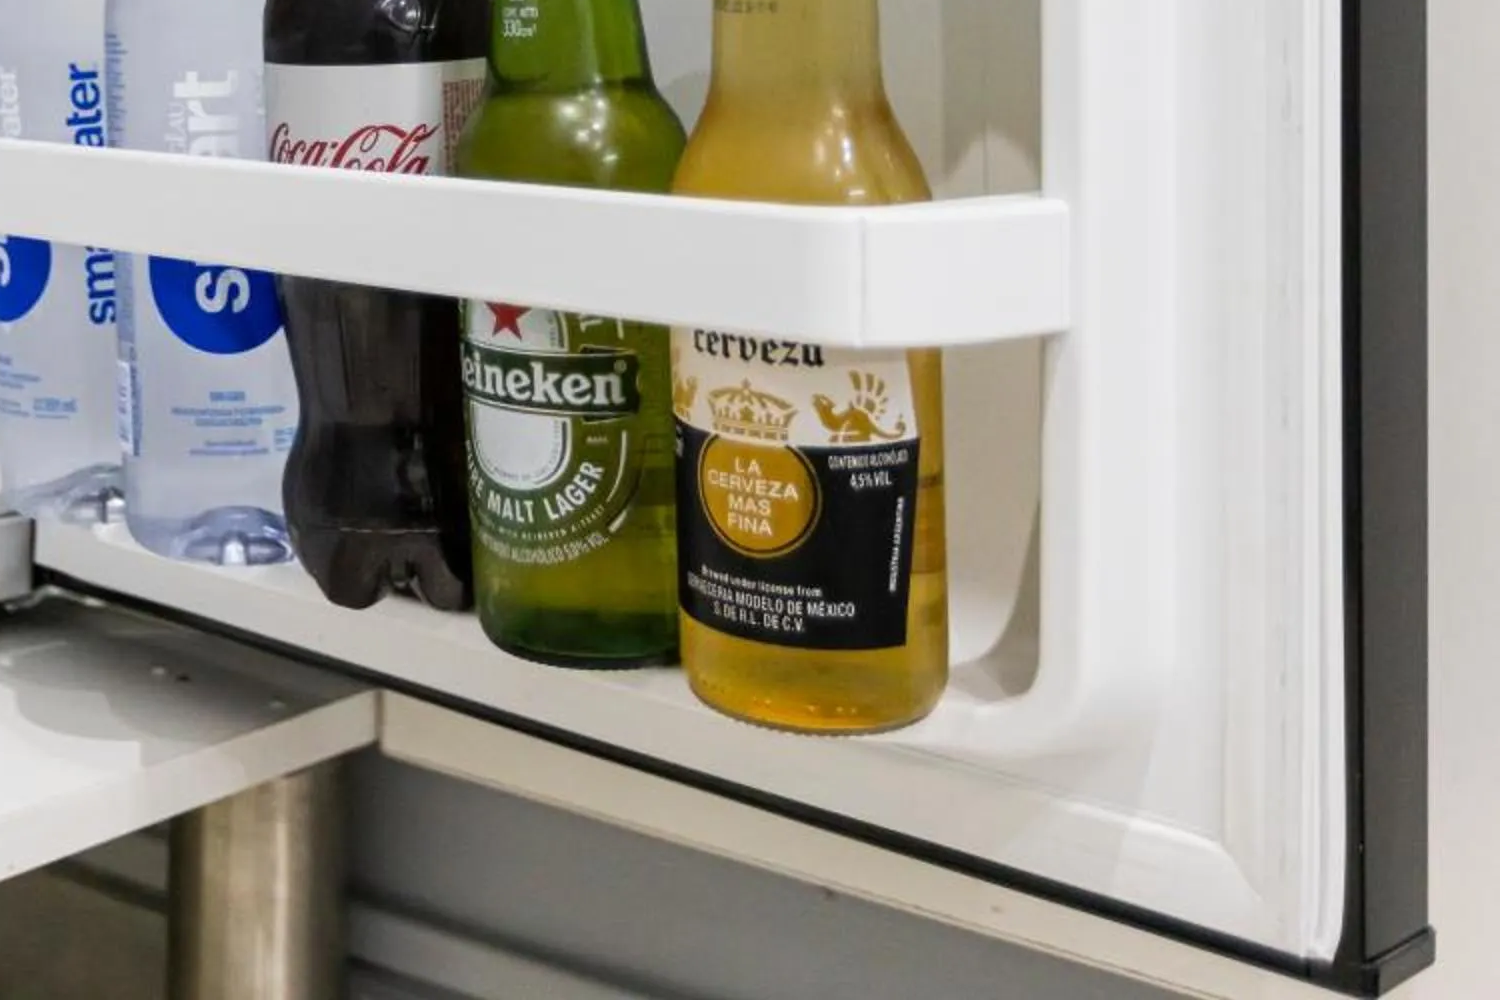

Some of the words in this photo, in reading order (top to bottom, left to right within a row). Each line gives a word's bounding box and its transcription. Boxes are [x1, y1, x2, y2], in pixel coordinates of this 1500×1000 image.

[461, 350, 627, 406] eineken
[734, 455, 763, 477] LA
[486, 489, 535, 524] MALT
[542, 460, 606, 521] LAGER
[707, 468, 800, 503] CERVEZA
[727, 491, 772, 517] MAS
[727, 510, 774, 537] FINA
[735, 590, 784, 614] MODELO
[787, 600, 803, 615] DE
[763, 612, 780, 630] DE
